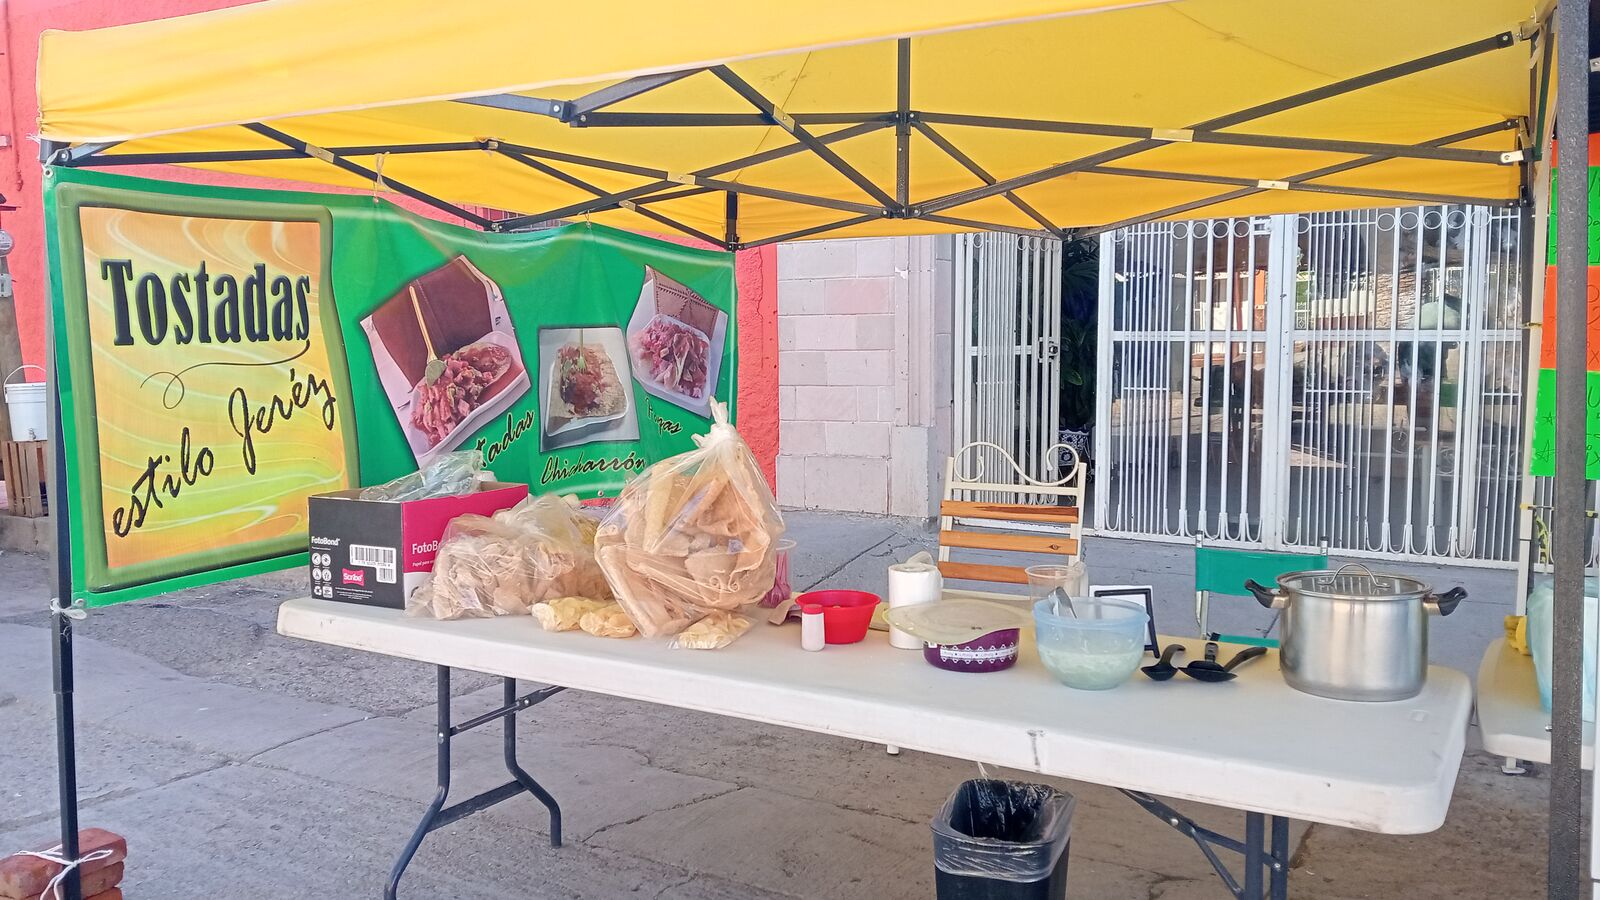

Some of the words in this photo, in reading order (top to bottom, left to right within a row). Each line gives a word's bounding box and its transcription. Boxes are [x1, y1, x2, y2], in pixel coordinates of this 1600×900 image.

[100, 258, 310, 346] Tostadas
[112, 426, 214, 538] estilo
[541, 451, 645, 485] Chicharrón
[412, 540, 438, 555] FotoB
[343, 572, 363, 582] Scribe
